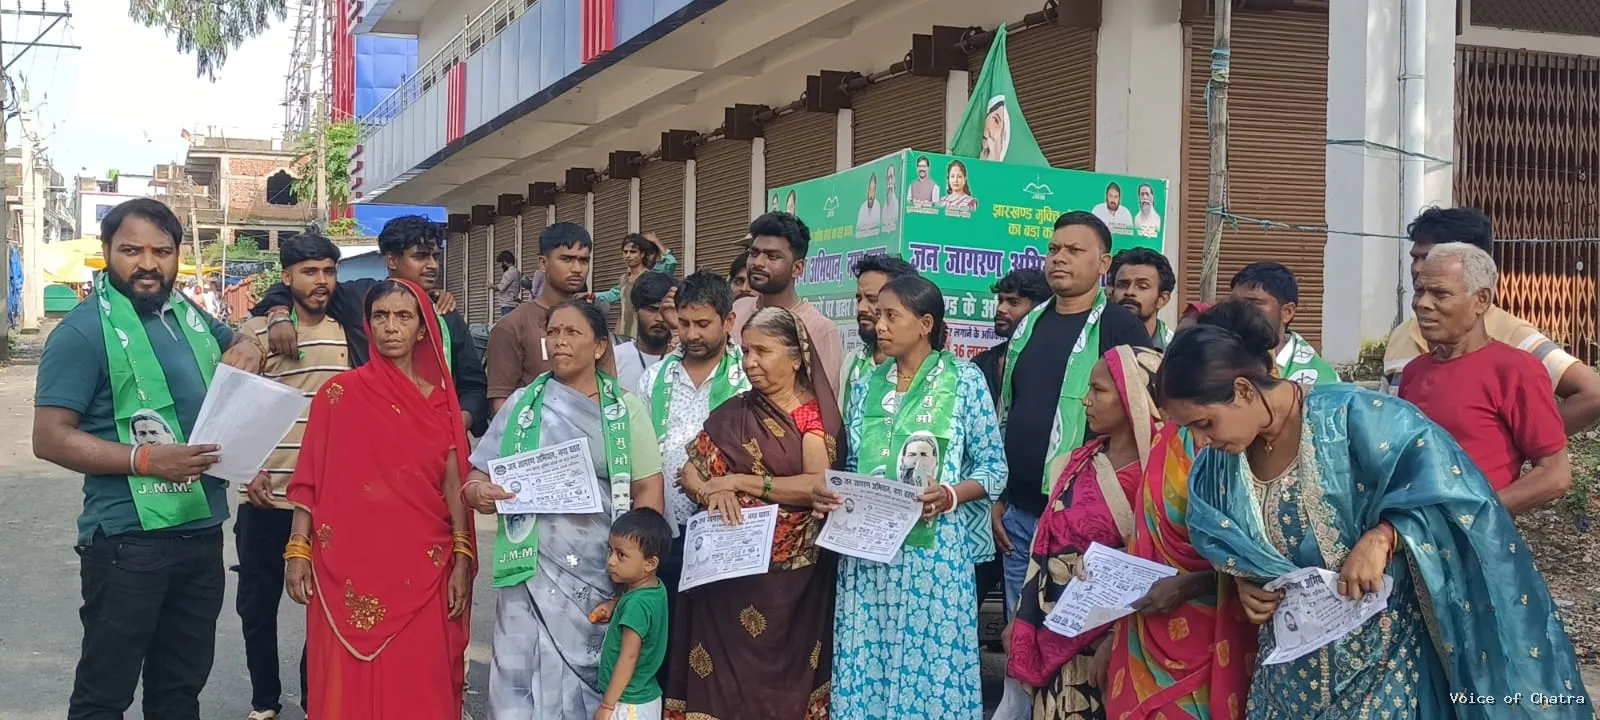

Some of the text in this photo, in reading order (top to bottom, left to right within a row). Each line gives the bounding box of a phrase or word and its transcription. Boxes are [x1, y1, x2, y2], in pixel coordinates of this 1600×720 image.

[992, 204, 1033, 219] झारखण्ड
[1008, 223, 1021, 236] का
[909, 243, 941, 273] जन
[943, 246, 1005, 278] जागरण
[962, 292, 977, 317] के
[954, 326, 972, 338] लगाने
[973, 327, 980, 339] के
[138, 482, 192, 496] J.M.M.
[499, 546, 536, 563] J.M.M.
